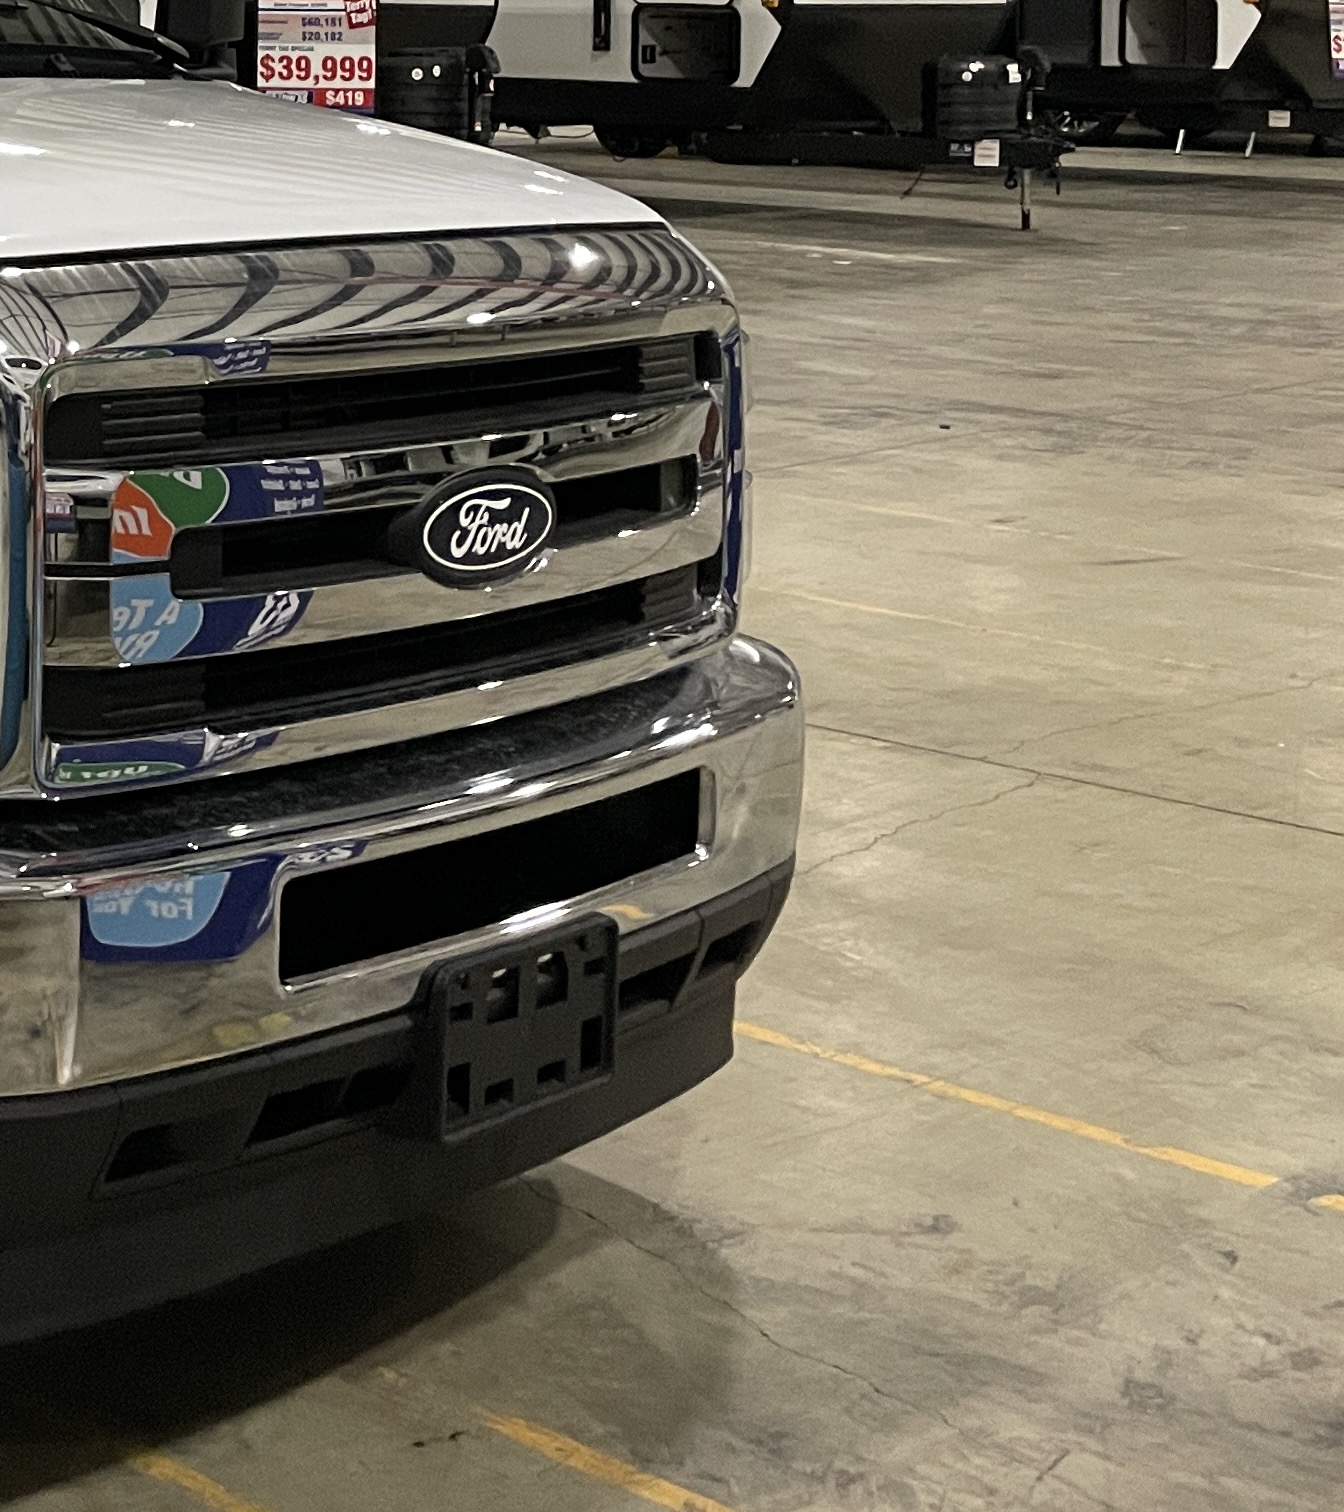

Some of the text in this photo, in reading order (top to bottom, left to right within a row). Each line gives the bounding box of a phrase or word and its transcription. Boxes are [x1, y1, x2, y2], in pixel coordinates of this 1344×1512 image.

[259, 53, 373, 85] $39,999
[325, 90, 365, 106] $419
[450, 497, 530, 559] Ford
